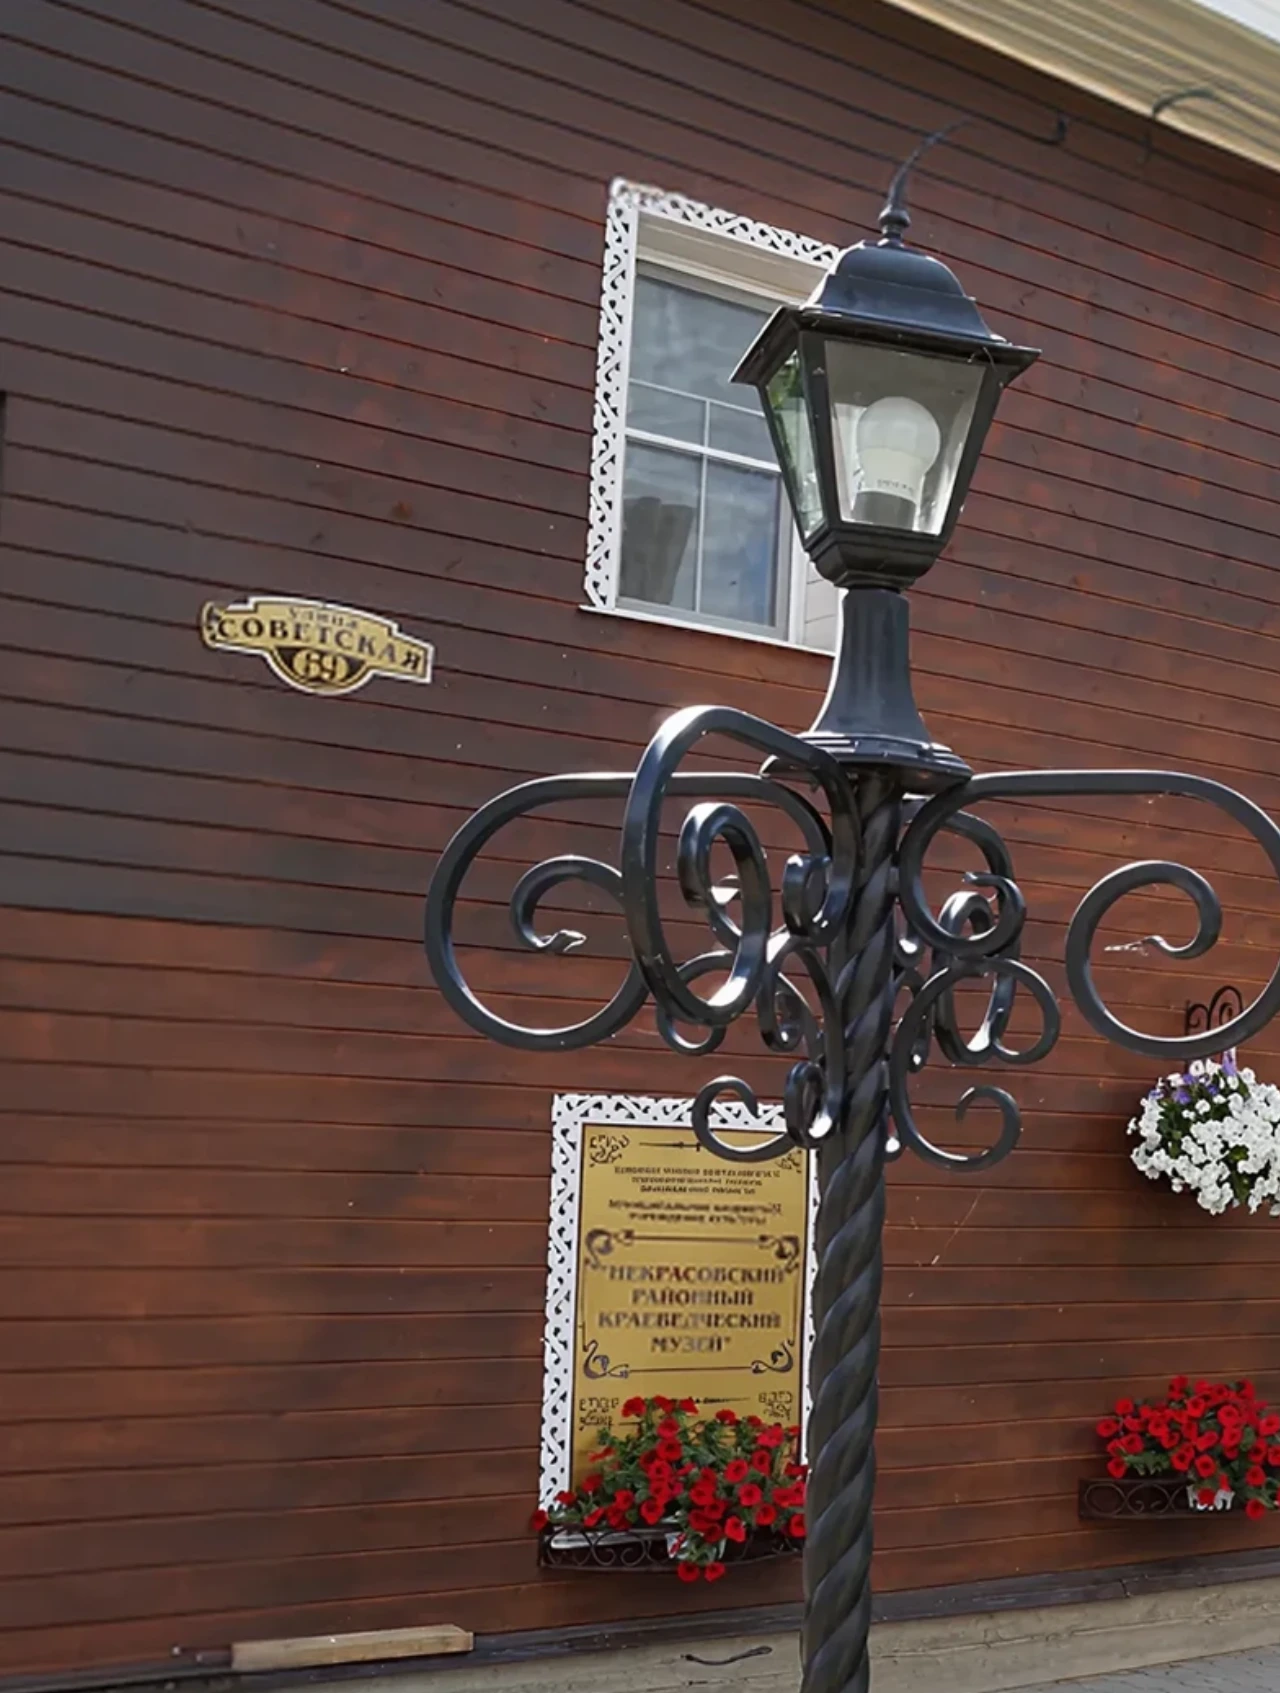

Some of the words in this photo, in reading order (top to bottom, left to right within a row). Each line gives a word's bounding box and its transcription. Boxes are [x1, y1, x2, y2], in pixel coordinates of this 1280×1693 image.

[217, 617, 422, 671] СОВЕТСКАЯ
[293, 648, 348, 680] 69
[631, 1286, 755, 1306] РАЙОННЫЙ
[598, 1310, 782, 1329] КРАЕВЕДЧЕСКИЙ
